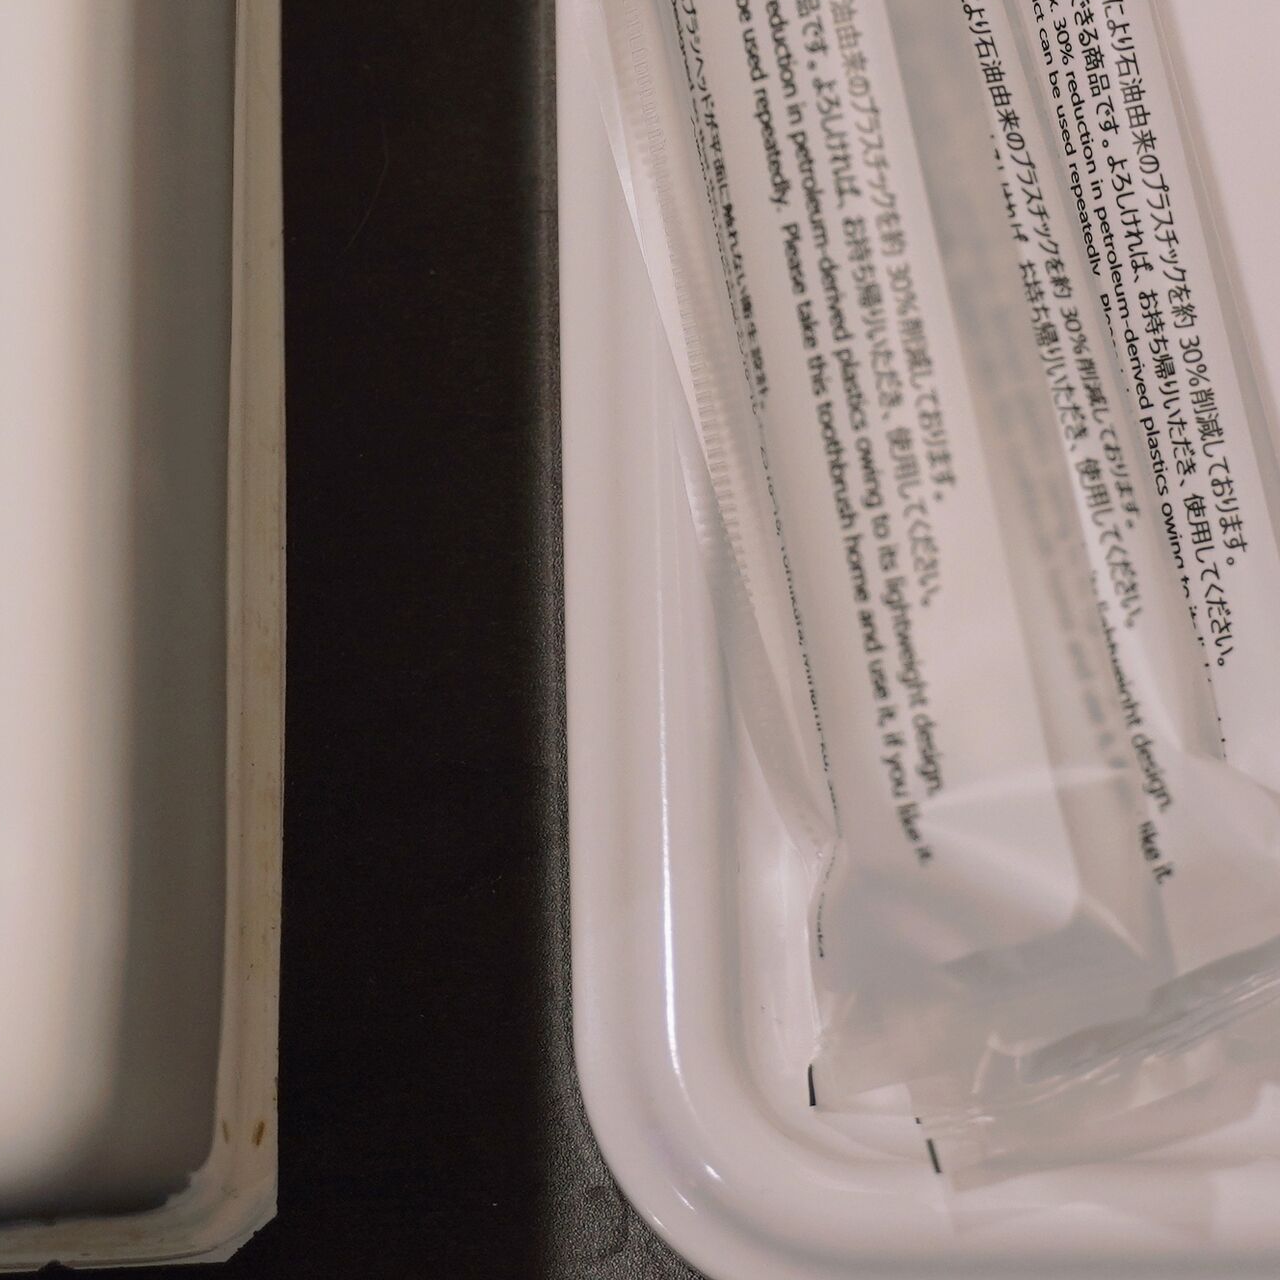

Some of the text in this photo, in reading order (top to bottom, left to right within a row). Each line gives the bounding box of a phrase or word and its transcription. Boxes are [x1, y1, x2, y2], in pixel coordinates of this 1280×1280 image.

[741, 27, 770, 84] used
[1052, 16, 1076, 67] 30%
[785, 101, 806, 127] in
[1038, 26, 1054, 67] can
[1047, 68, 1062, 100] be
[1055, 103, 1078, 157] used
[753, 87, 792, 211] repeatedly.
[1064, 70, 1098, 176] reduction
[1089, 177, 1105, 202] in
[780, 221, 808, 296] Please
[786, 129, 854, 343] petroleum-derived
[795, 299, 820, 350] take
[1092, 205, 1155, 411] petroleum-derived
[806, 353, 829, 398] this
[831, 346, 868, 433] plastics
[816, 400, 859, 531] toothbrush
[854, 436, 884, 511] owing
[1138, 415, 1170, 498] plastics
[869, 511, 892, 541] to
[843, 532, 871, 604] home
[877, 543, 899, 574] its
[857, 608, 886, 655] and
[879, 575, 929, 709] lightweight
[867, 658, 890, 701] use
[882, 732, 906, 748] if
[880, 752, 909, 799] you
[896, 802, 922, 844] like
